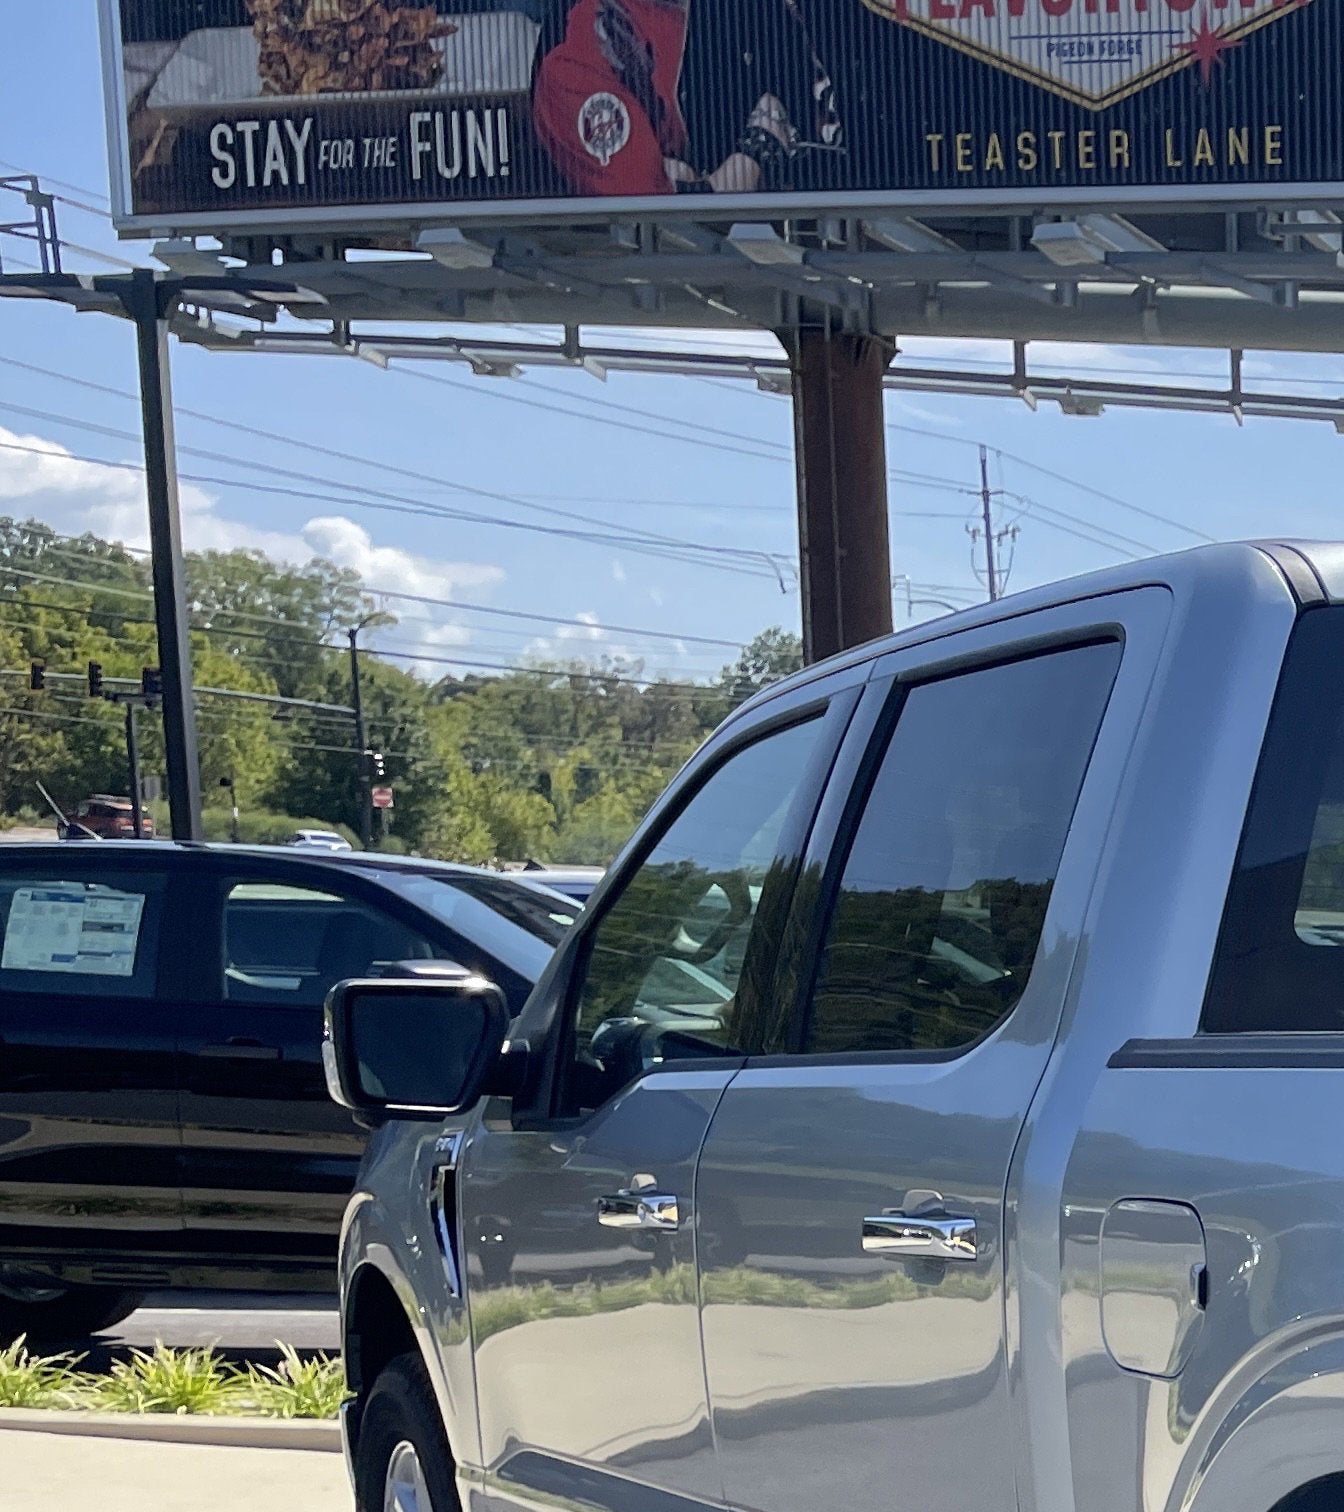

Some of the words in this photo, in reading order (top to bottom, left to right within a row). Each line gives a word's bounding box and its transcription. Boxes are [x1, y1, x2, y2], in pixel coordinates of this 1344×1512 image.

[210, 117, 314, 189] STAY
[318, 138, 354, 170] FOR
[362, 136, 398, 168] THE
[410, 108, 509, 179] FUN!
[926, 128, 1130, 171] TEASTER
[1165, 125, 1283, 167] LANE
